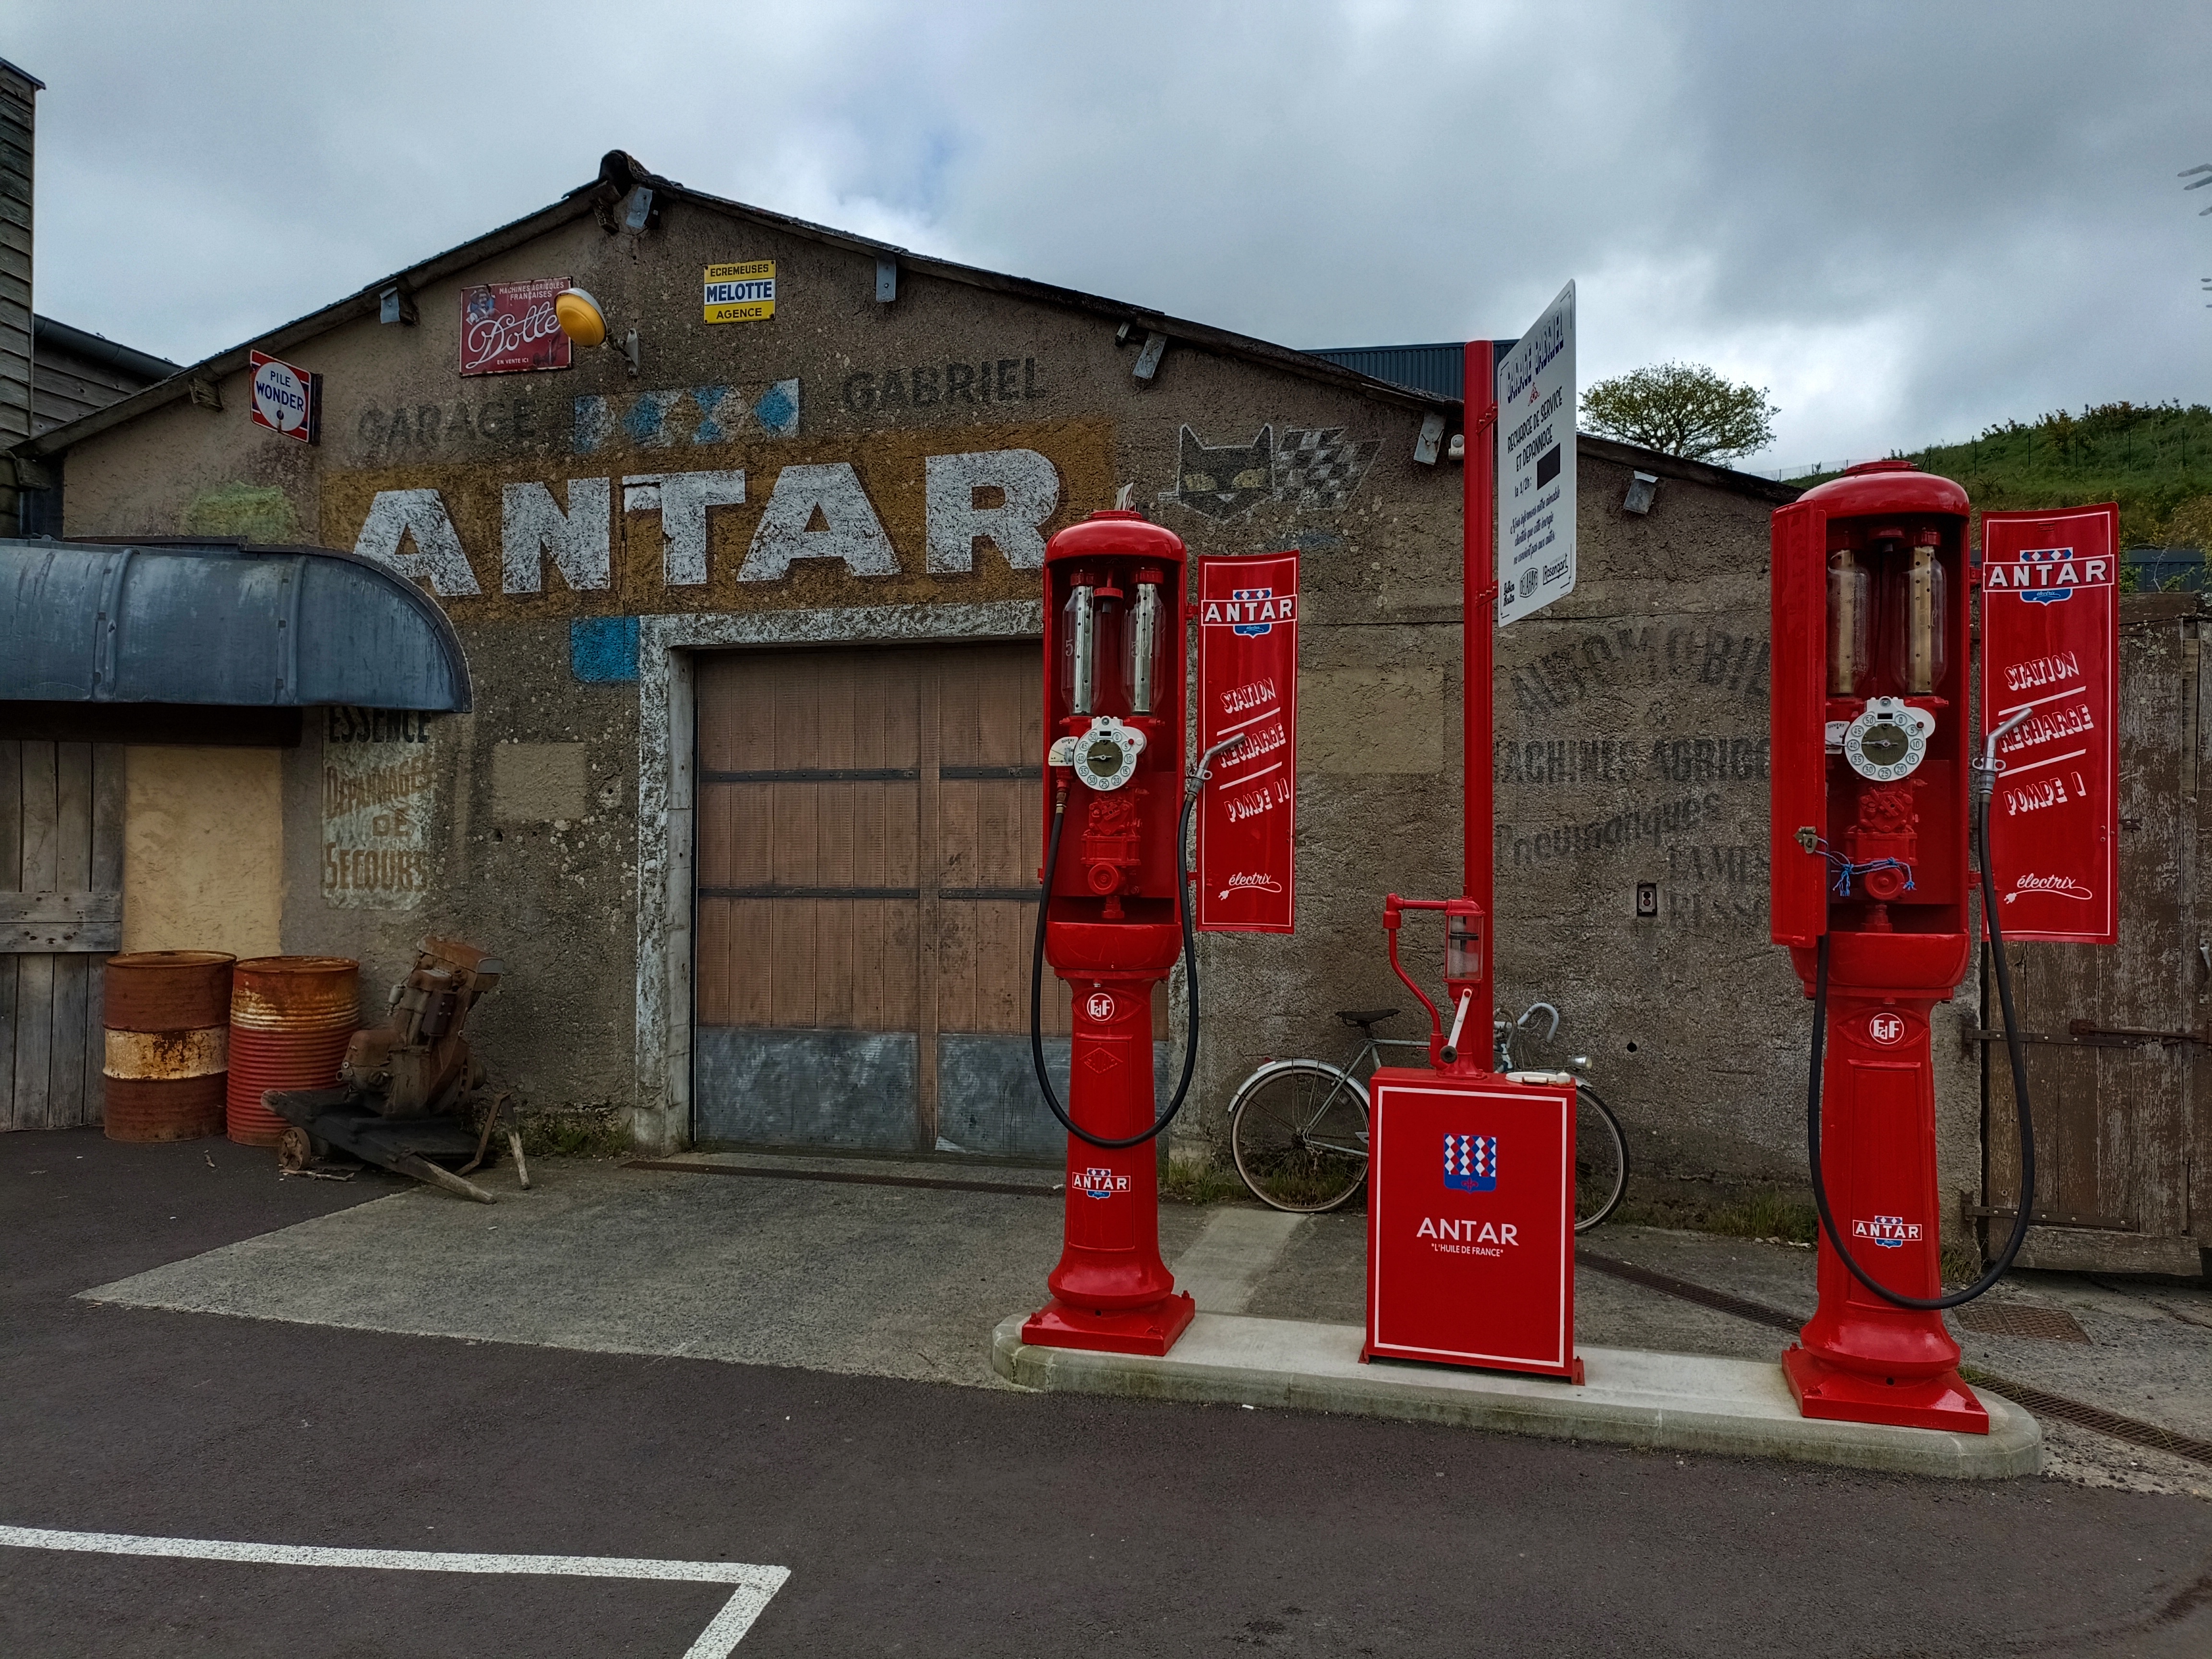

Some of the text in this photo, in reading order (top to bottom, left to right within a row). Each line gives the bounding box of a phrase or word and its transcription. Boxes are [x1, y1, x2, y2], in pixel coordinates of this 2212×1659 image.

[710, 264, 769, 277] ECREMEUSES
[499, 282, 565, 295] MACHINES AGRICOLES
[707, 281, 772, 302] MELOTTE
[716, 308, 762, 319] AGENCE
[1506, 307, 1564, 404] GARAGE GABRIEL
[270, 371, 291, 387] PILE
[842, 357, 1047, 409] GABRIEL
[256, 381, 304, 412] WONDER
[1508, 385, 1563, 454] RECHARGE DE SERVICE
[1516, 423, 1553, 472] ET DEPANNAGE
[353, 448, 1046, 596] ANTAR
[1520, 570, 1538, 595] DELAHAYE
[1988, 560, 2106, 587] ANTAR
[1204, 599, 1292, 622] ANTAR
[1511, 626, 1771, 719] AUTOMOBIL
[2004, 651, 2080, 691] STATION
[1220, 677, 1276, 714] STATION
[328, 706, 432, 743] ESSENCE
[1998, 704, 2094, 753] RECHARGE
[1217, 722, 1286, 768] RECHARGE
[1493, 740, 1637, 783] ACHINES
[1224, 787, 1273, 823] POMPE
[2003, 777, 2068, 816] POMPE
[326, 842, 429, 892] SECOURS
[1228, 872, 1271, 886] électrix
[2017, 873, 2076, 889] électrix
[1090, 1000, 1110, 1017] EdF
[1873, 1020, 1900, 1040] EdF
[1074, 1175, 1127, 1190] ANTAR
[1416, 1217, 1519, 1246] ANTAR
[1855, 1222, 1919, 1238] ANTAR
[1461, 1246, 1471, 1254] DE
